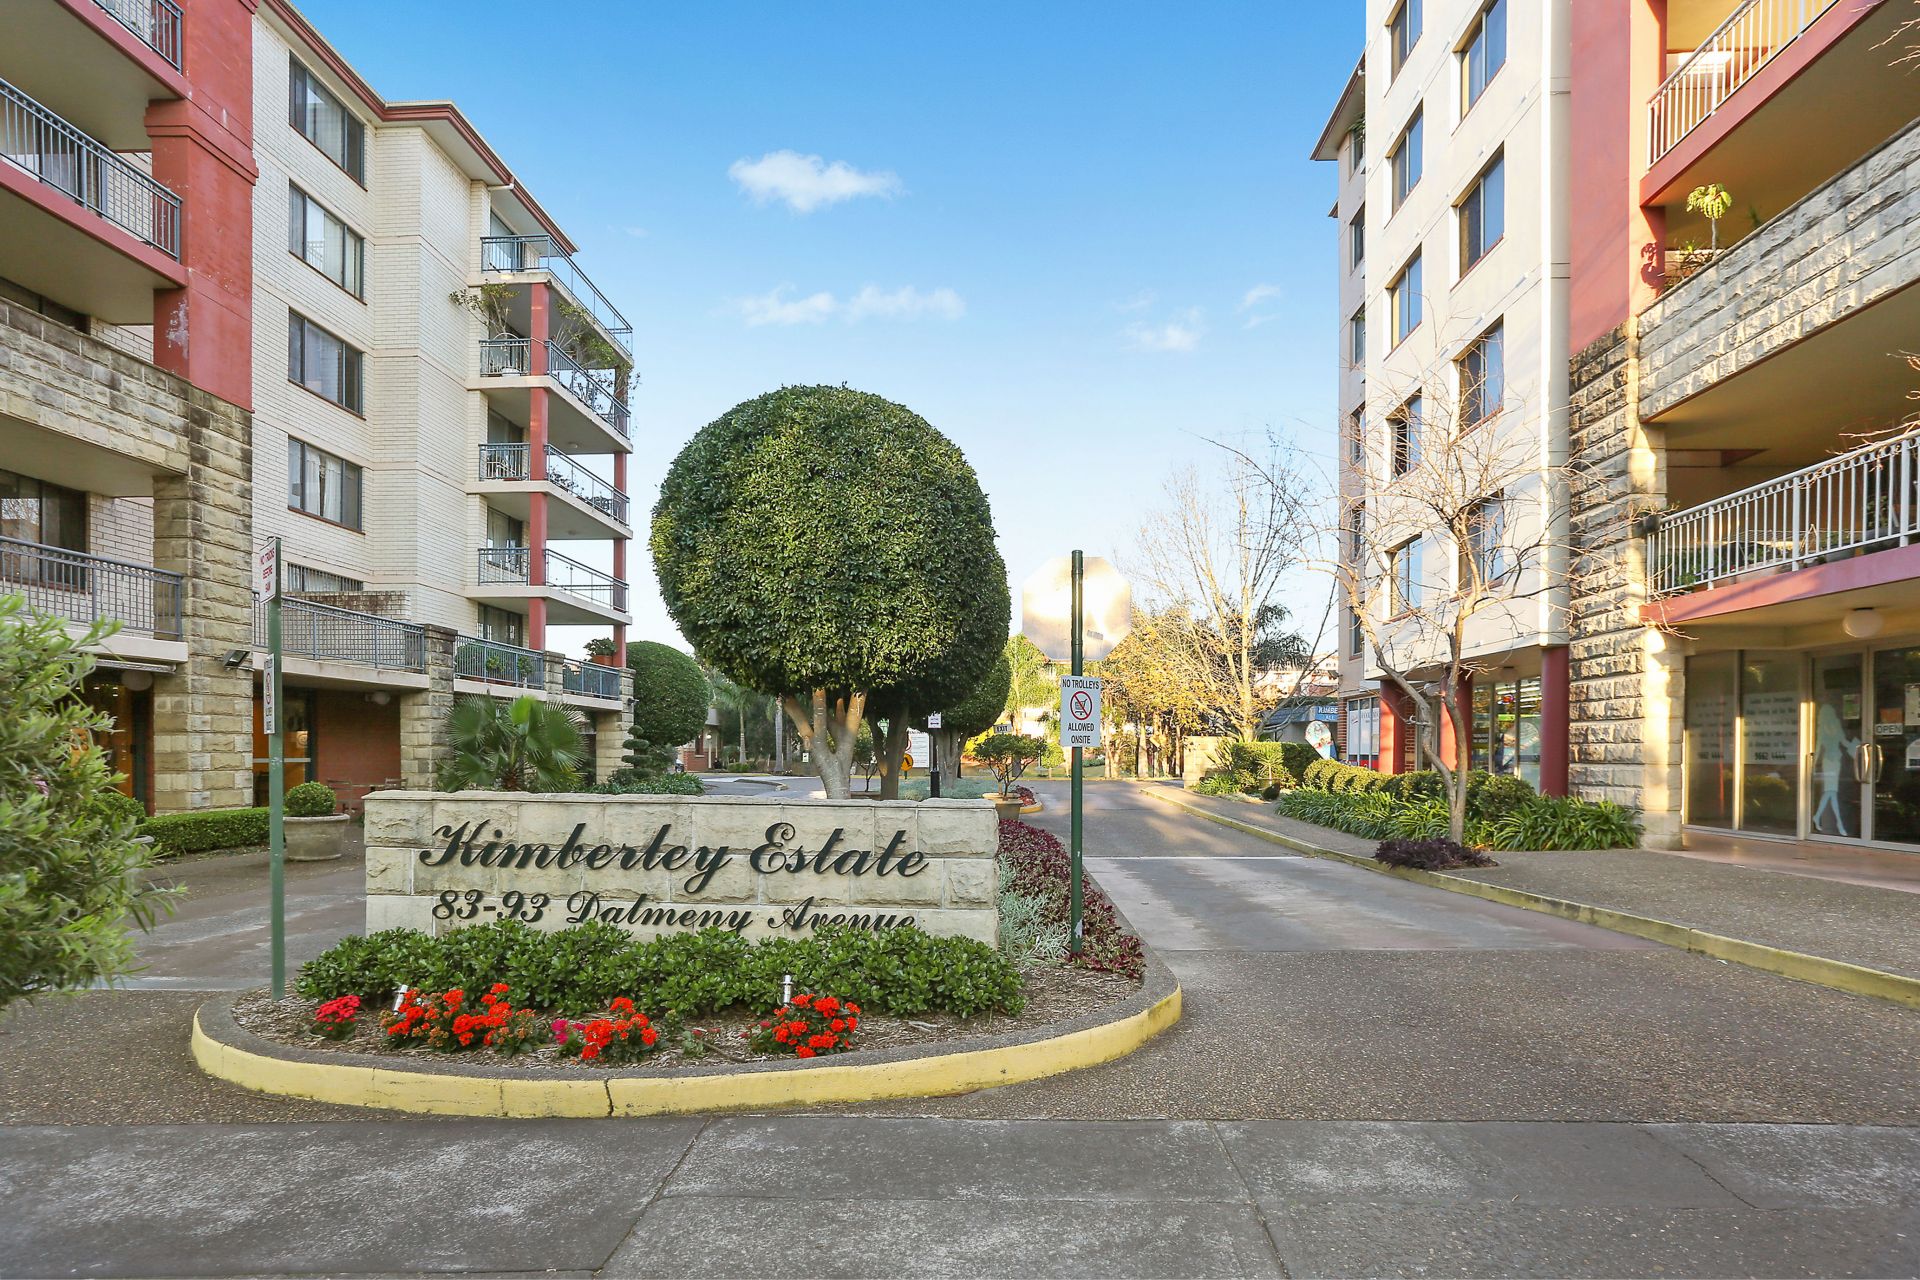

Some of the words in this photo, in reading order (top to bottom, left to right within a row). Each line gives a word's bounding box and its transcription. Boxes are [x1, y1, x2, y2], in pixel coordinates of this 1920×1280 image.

[1062, 679, 1071, 688] NO
[1072, 680, 1100, 690] TROLLEYS
[996, 725, 1008, 733] EXIT
[1068, 722, 1095, 732] ALLOWED
[1875, 725, 1902, 734] OPEN
[1070, 735, 1091, 744] ONSITE
[419, 818, 733, 894] Kimberley
[749, 821, 930, 877] Estate
[431, 889, 550, 923] 83-93
[566, 890, 754, 934] Dalmeny
[767, 895, 917, 931] Avenue
